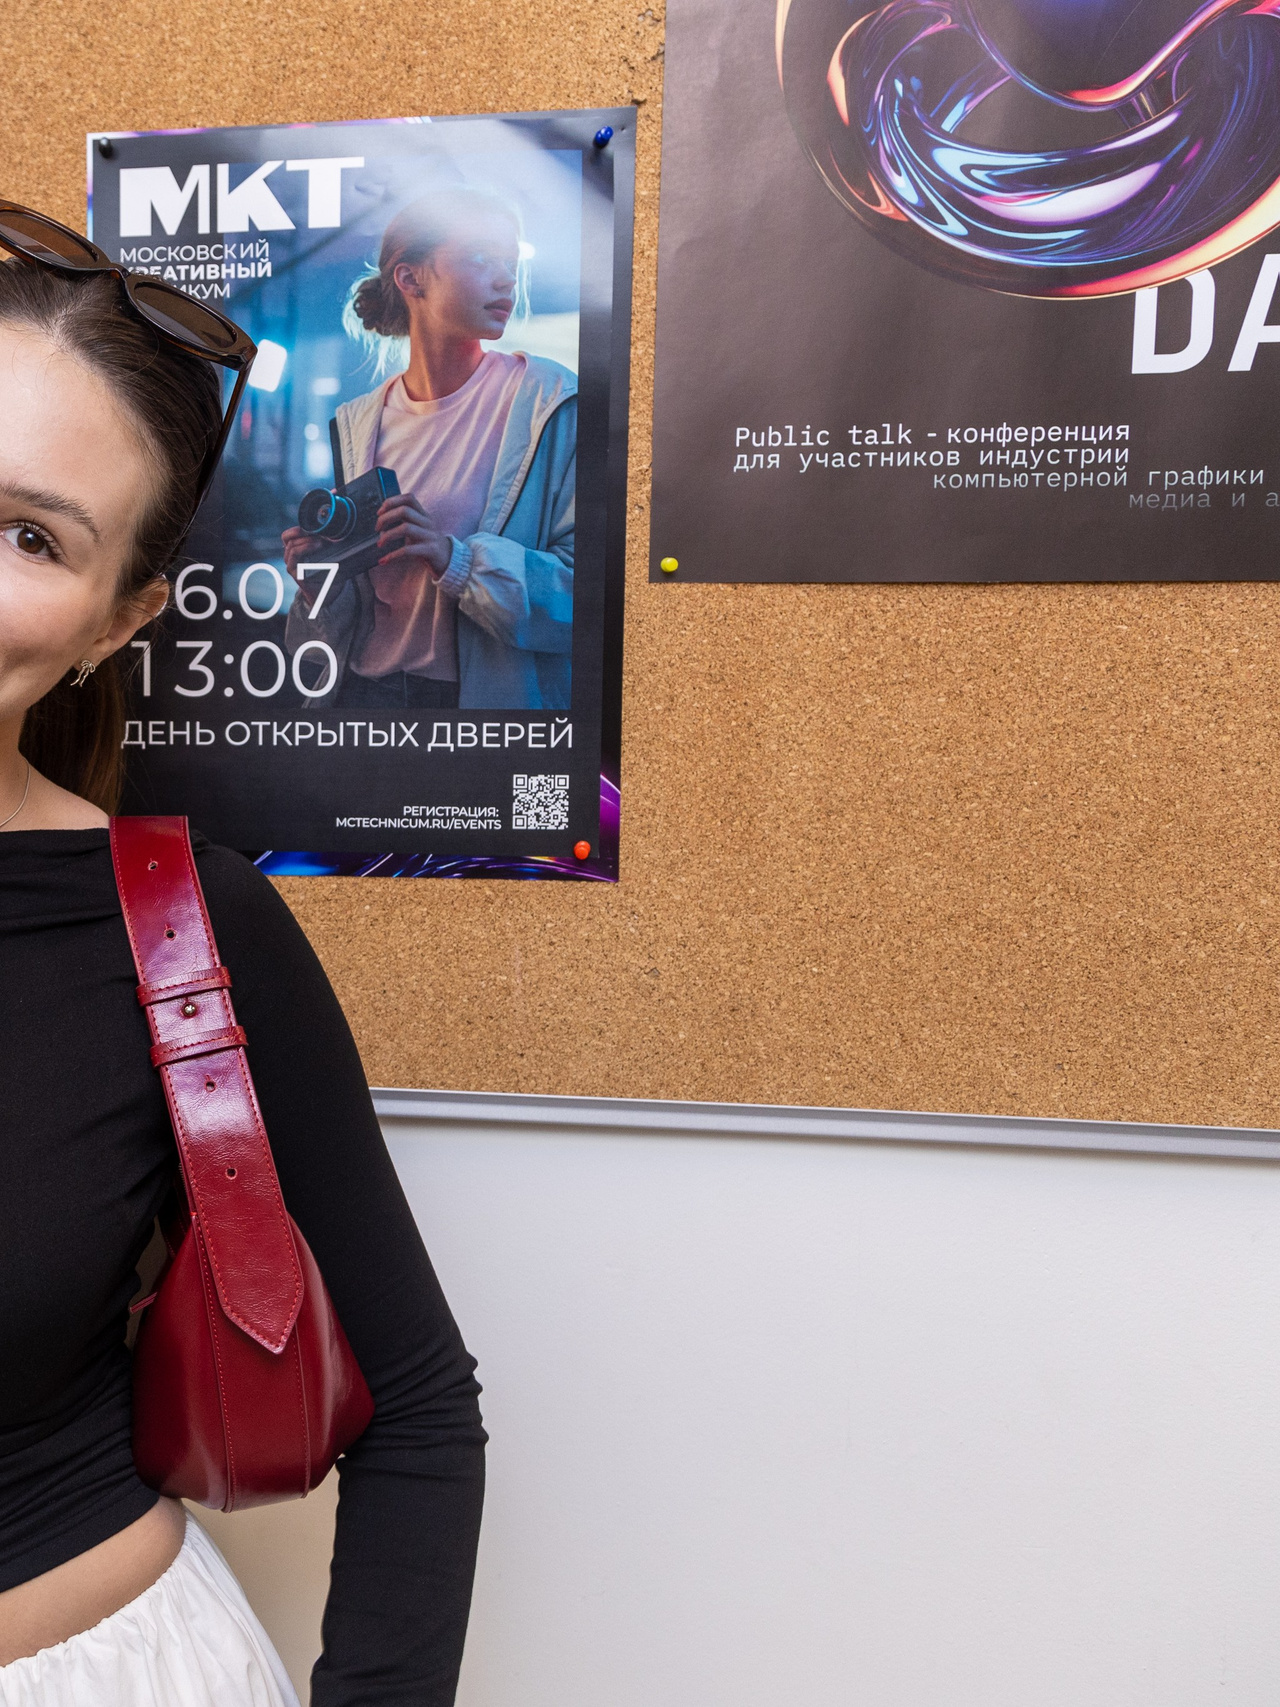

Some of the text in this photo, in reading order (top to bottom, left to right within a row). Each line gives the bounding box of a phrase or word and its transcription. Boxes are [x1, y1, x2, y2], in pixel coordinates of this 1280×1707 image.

[120, 238, 270, 264] МОСКОВСКИЙ
[735, 424, 830, 447] Public
[848, 423, 912, 445] talk
[947, 422, 1131, 448] конференция
[733, 446, 1130, 474] для участников индустрии
[933, 465, 1265, 492] компьютерной графики
[1129, 492, 1211, 513] медиа
[1231, 493, 1246, 507] и
[157, 562, 340, 621] 6.07
[130, 640, 338, 697] 13:00
[121, 717, 573, 752] ДЕНЬ ОТКРЫТЫХ ДВЕРЕЙ
[336, 817, 502, 830] MCTECHNICUM.RU/EVENTS
[403, 805, 499, 818] РЕГИСТРАЦИЯ:
